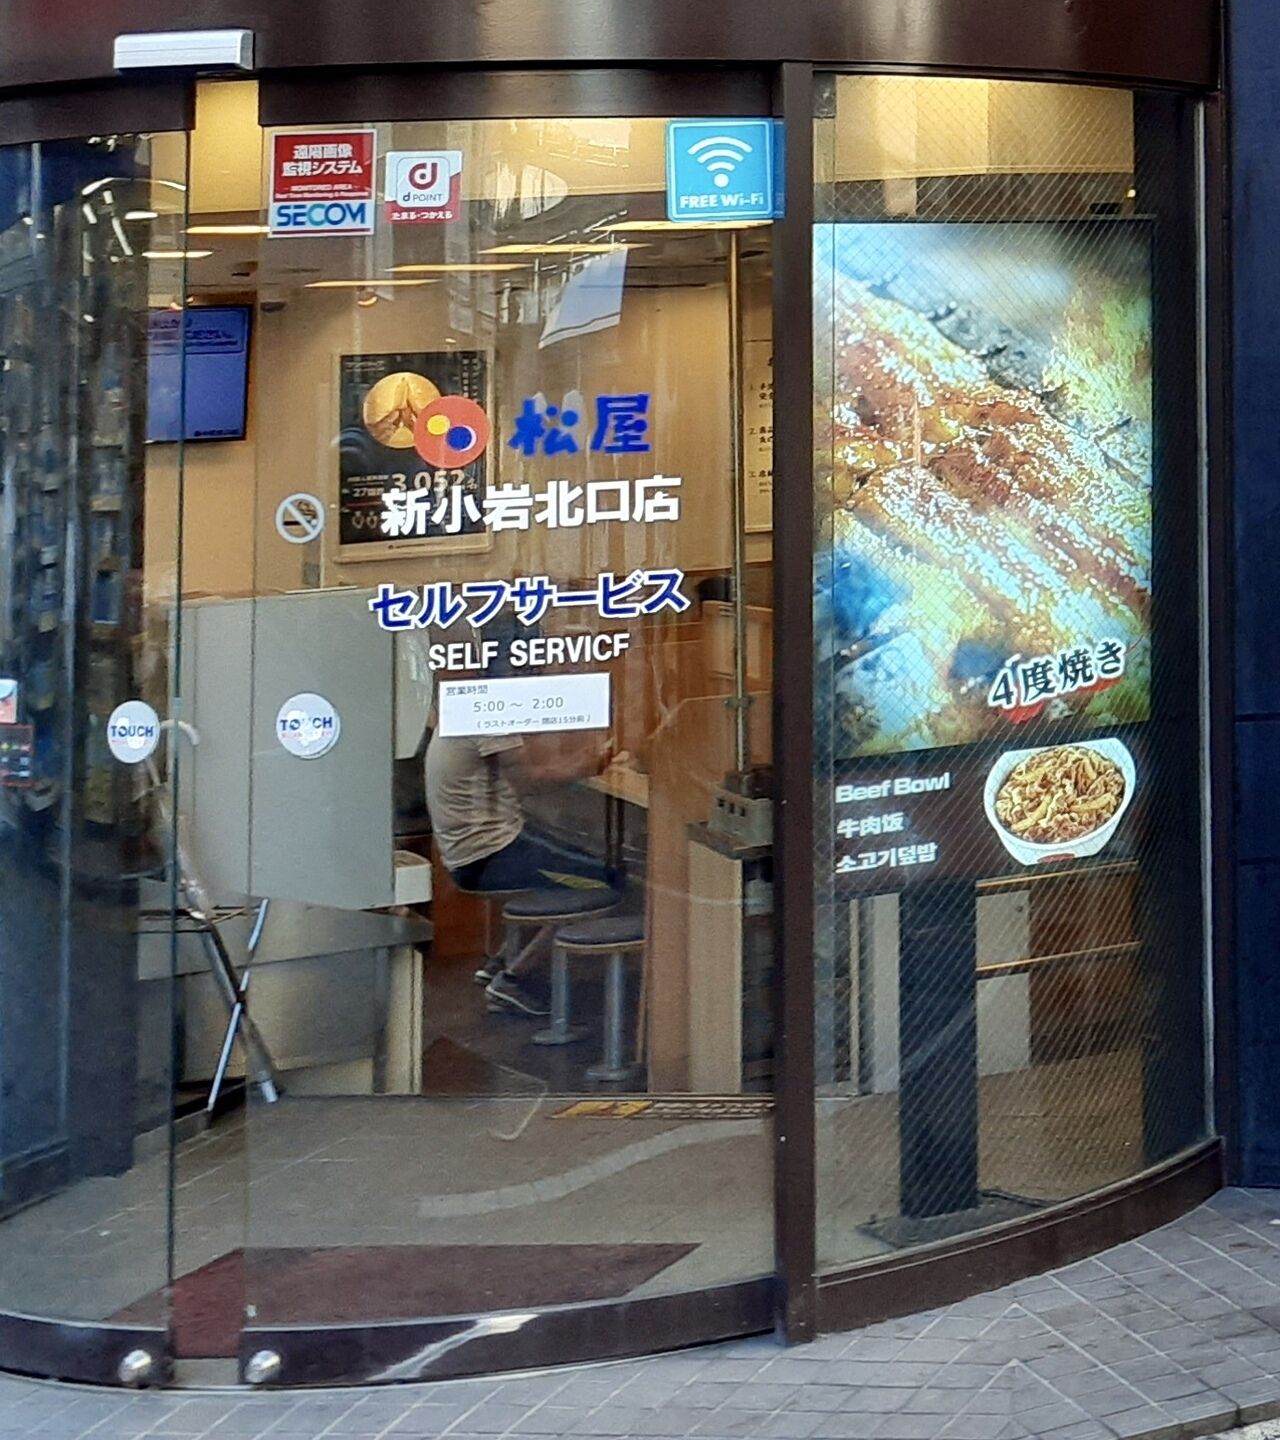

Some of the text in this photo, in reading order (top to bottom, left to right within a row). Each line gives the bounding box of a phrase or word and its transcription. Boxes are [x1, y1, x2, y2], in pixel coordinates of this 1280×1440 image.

[412, 193, 443, 202] POINT
[679, 191, 764, 209] FREE Wi-Fi
[276, 202, 366, 227] SECOM
[507, 392, 651, 457] 松屋
[380, 474, 682, 537] 新小岩北口店
[368, 568, 692, 631] セルフサービス
[427, 640, 499, 672] SELF
[987, 637, 1127, 711] 4度焼き
[472, 699, 506, 713] 5:00
[532, 696, 565, 711] 2:00
[110, 724, 154, 738] TOUCH
[279, 716, 334, 732] TOCH
[834, 771, 950, 804] Beef Bowl
[836, 811, 905, 840] 牛肉饭
[834, 841, 939, 875] 소고기덮밥
